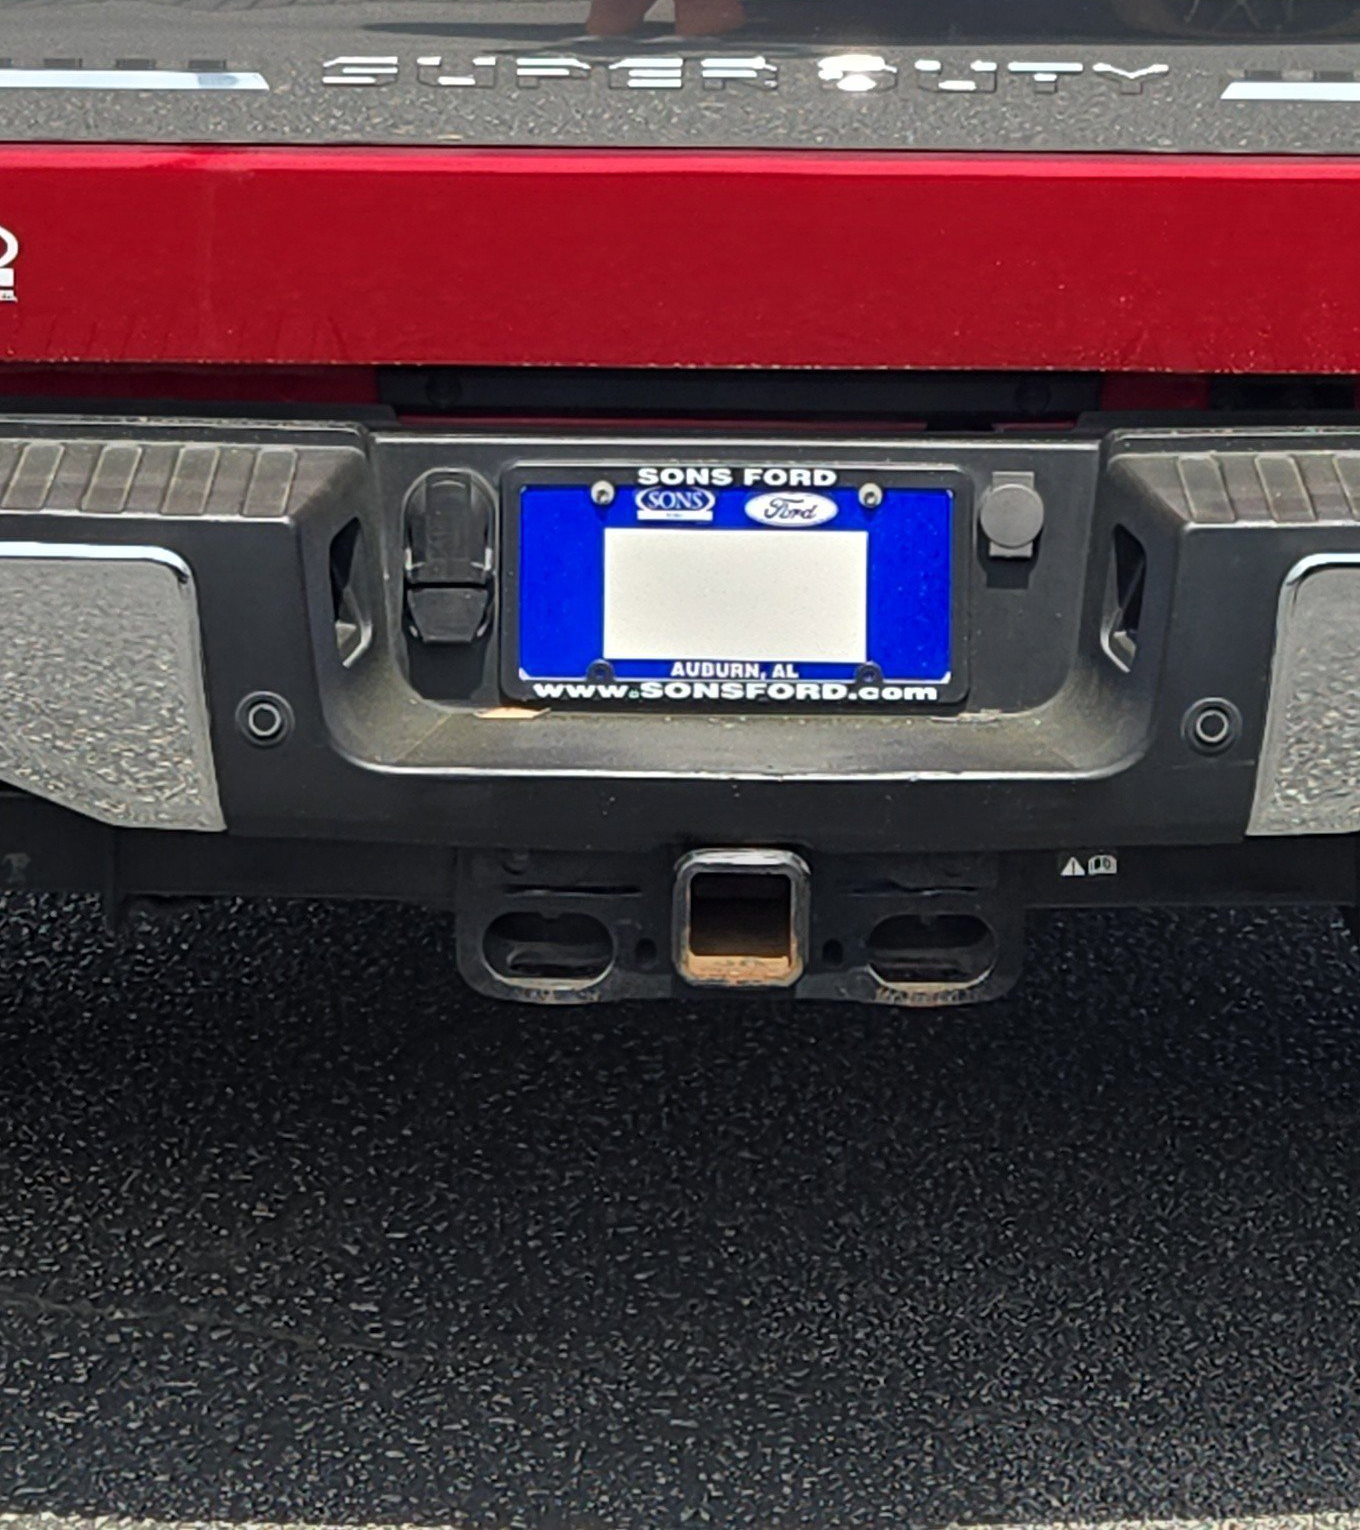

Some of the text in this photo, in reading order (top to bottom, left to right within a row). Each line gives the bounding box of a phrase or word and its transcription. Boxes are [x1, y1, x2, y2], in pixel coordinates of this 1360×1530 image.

[322, 54, 1170, 95] SUPER DUTY
[637, 467, 838, 487] SONS FORD
[647, 489, 704, 510] SONS
[764, 497, 819, 520] Ford
[772, 663, 800, 678] AL
[533, 680, 938, 702] www.SONSFORD.com
